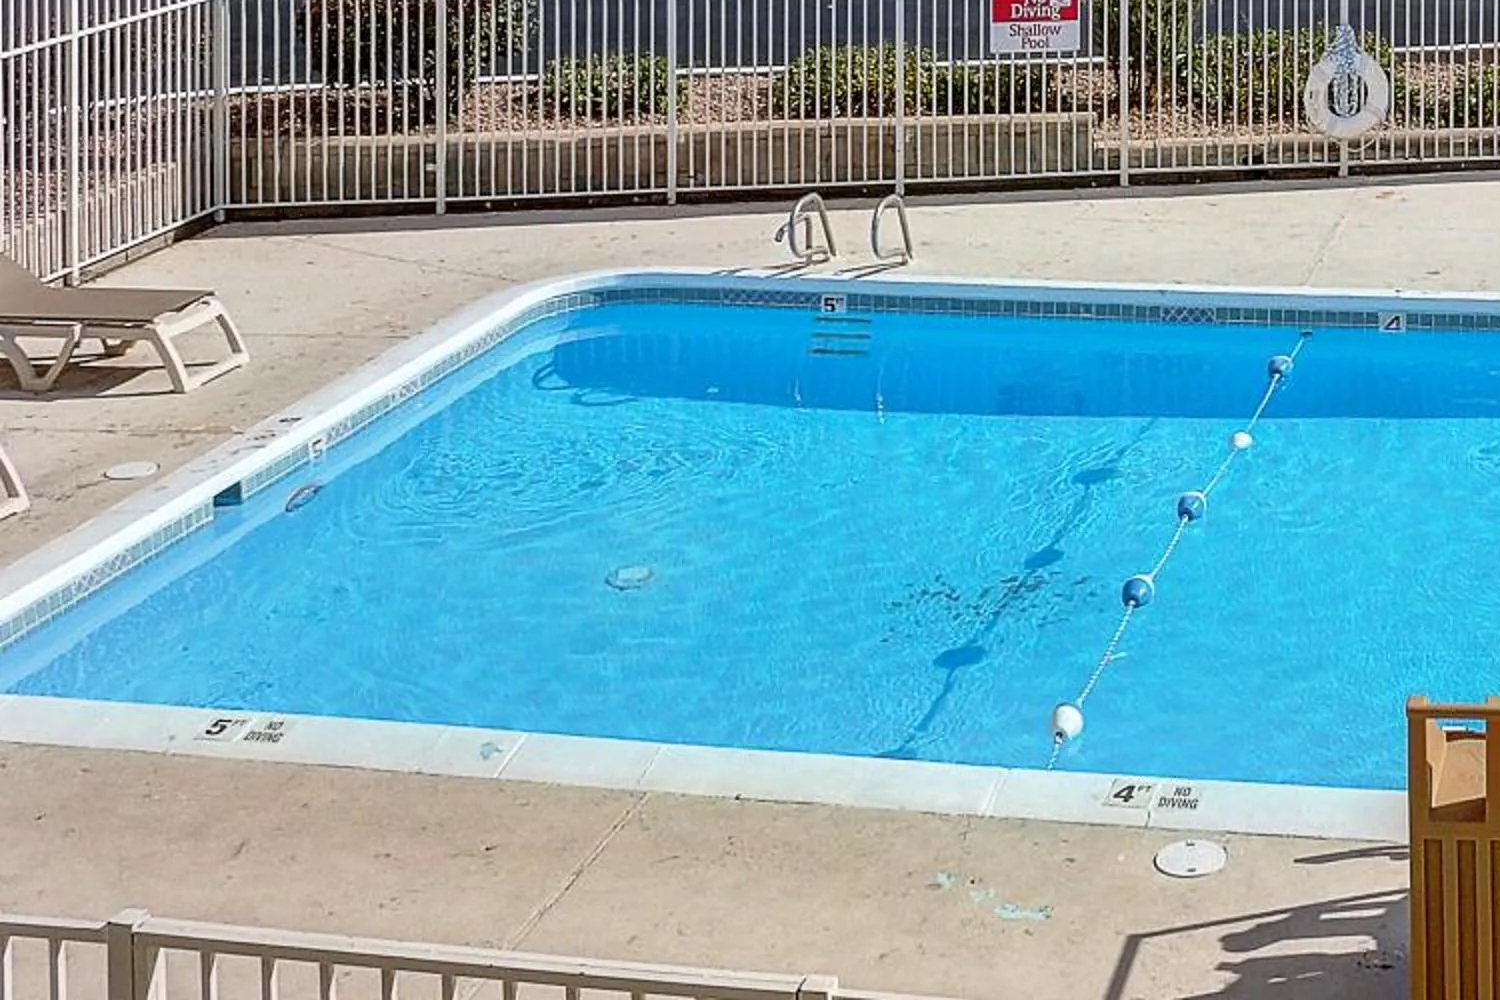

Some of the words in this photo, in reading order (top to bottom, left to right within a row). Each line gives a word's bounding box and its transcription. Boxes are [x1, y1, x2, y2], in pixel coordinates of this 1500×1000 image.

[1010, 4, 1061, 20] Diving
[1009, 24, 1061, 37] Shallow
[1021, 38, 1049, 49] Pool
[1173, 786, 1192, 797] NO
[1158, 795, 1199, 810] DIVING
